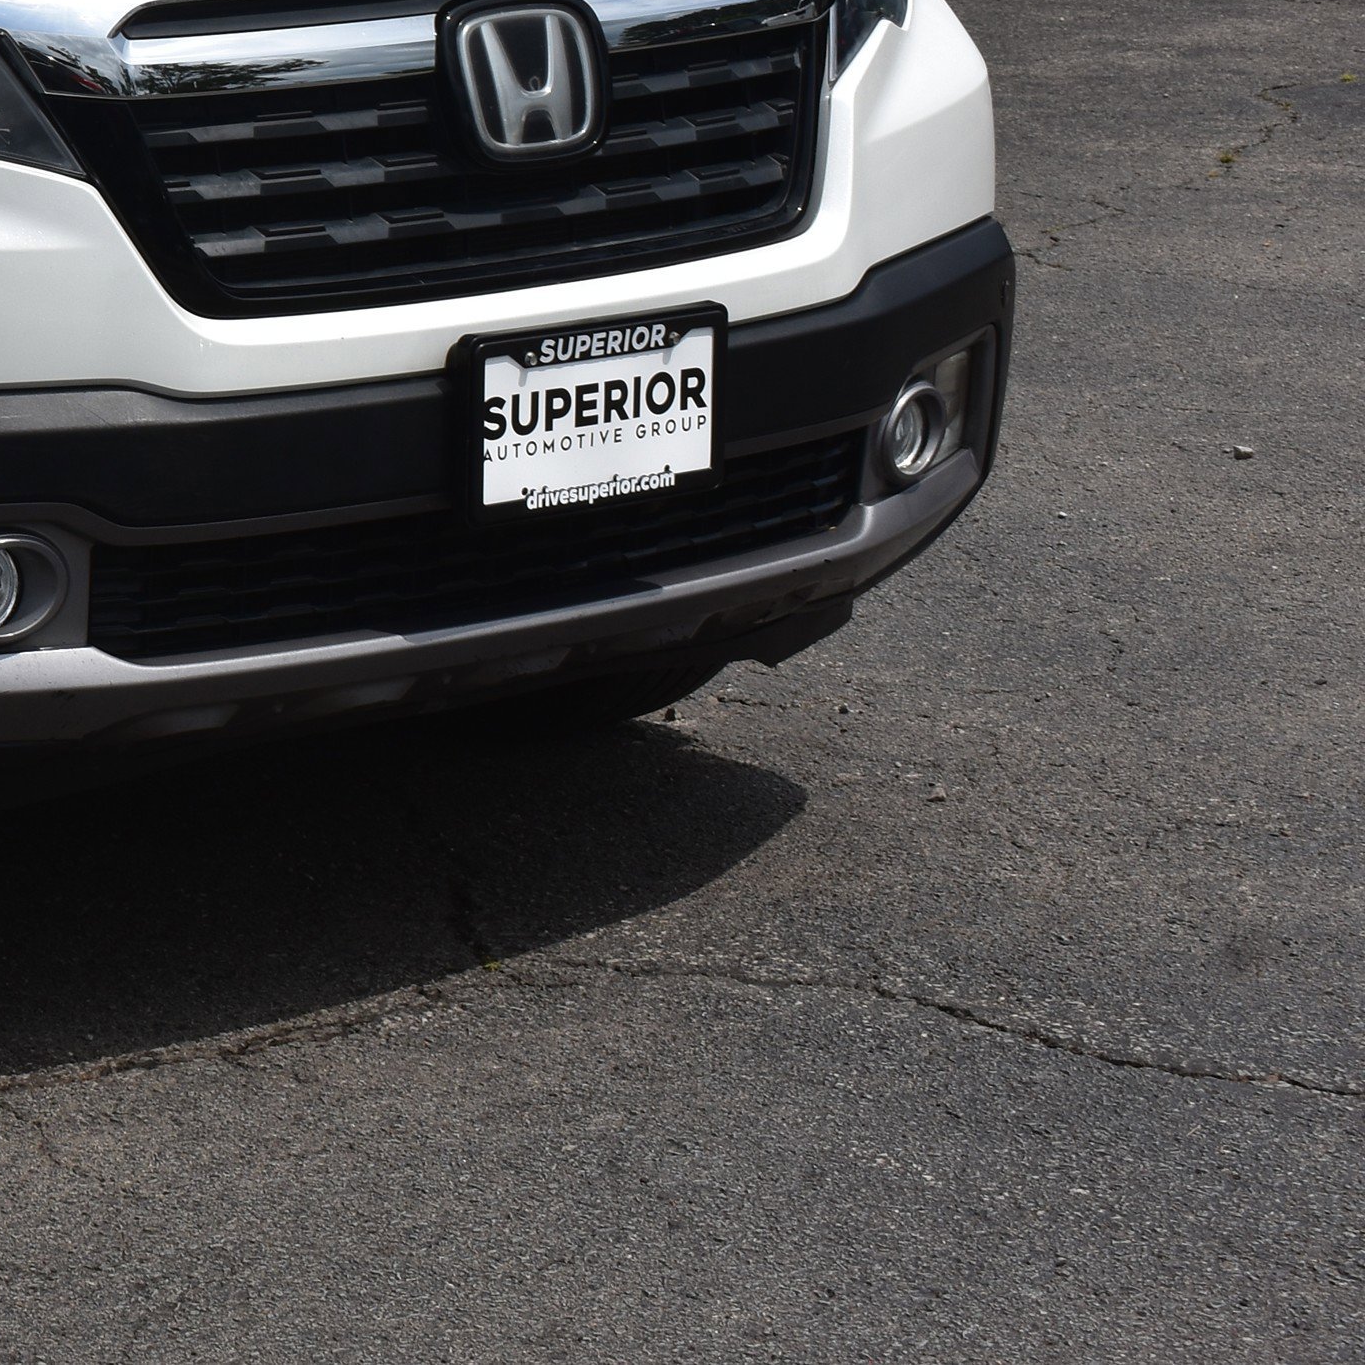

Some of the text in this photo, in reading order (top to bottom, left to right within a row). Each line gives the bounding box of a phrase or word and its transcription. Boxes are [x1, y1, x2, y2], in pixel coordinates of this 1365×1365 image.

[539, 323, 667, 364] SUPERIOR
[483, 367, 708, 441] SUPERIOR
[483, 415, 707, 463] AUTOMOTIVE GROUP
[526, 470, 676, 511] drivesuperior.com
